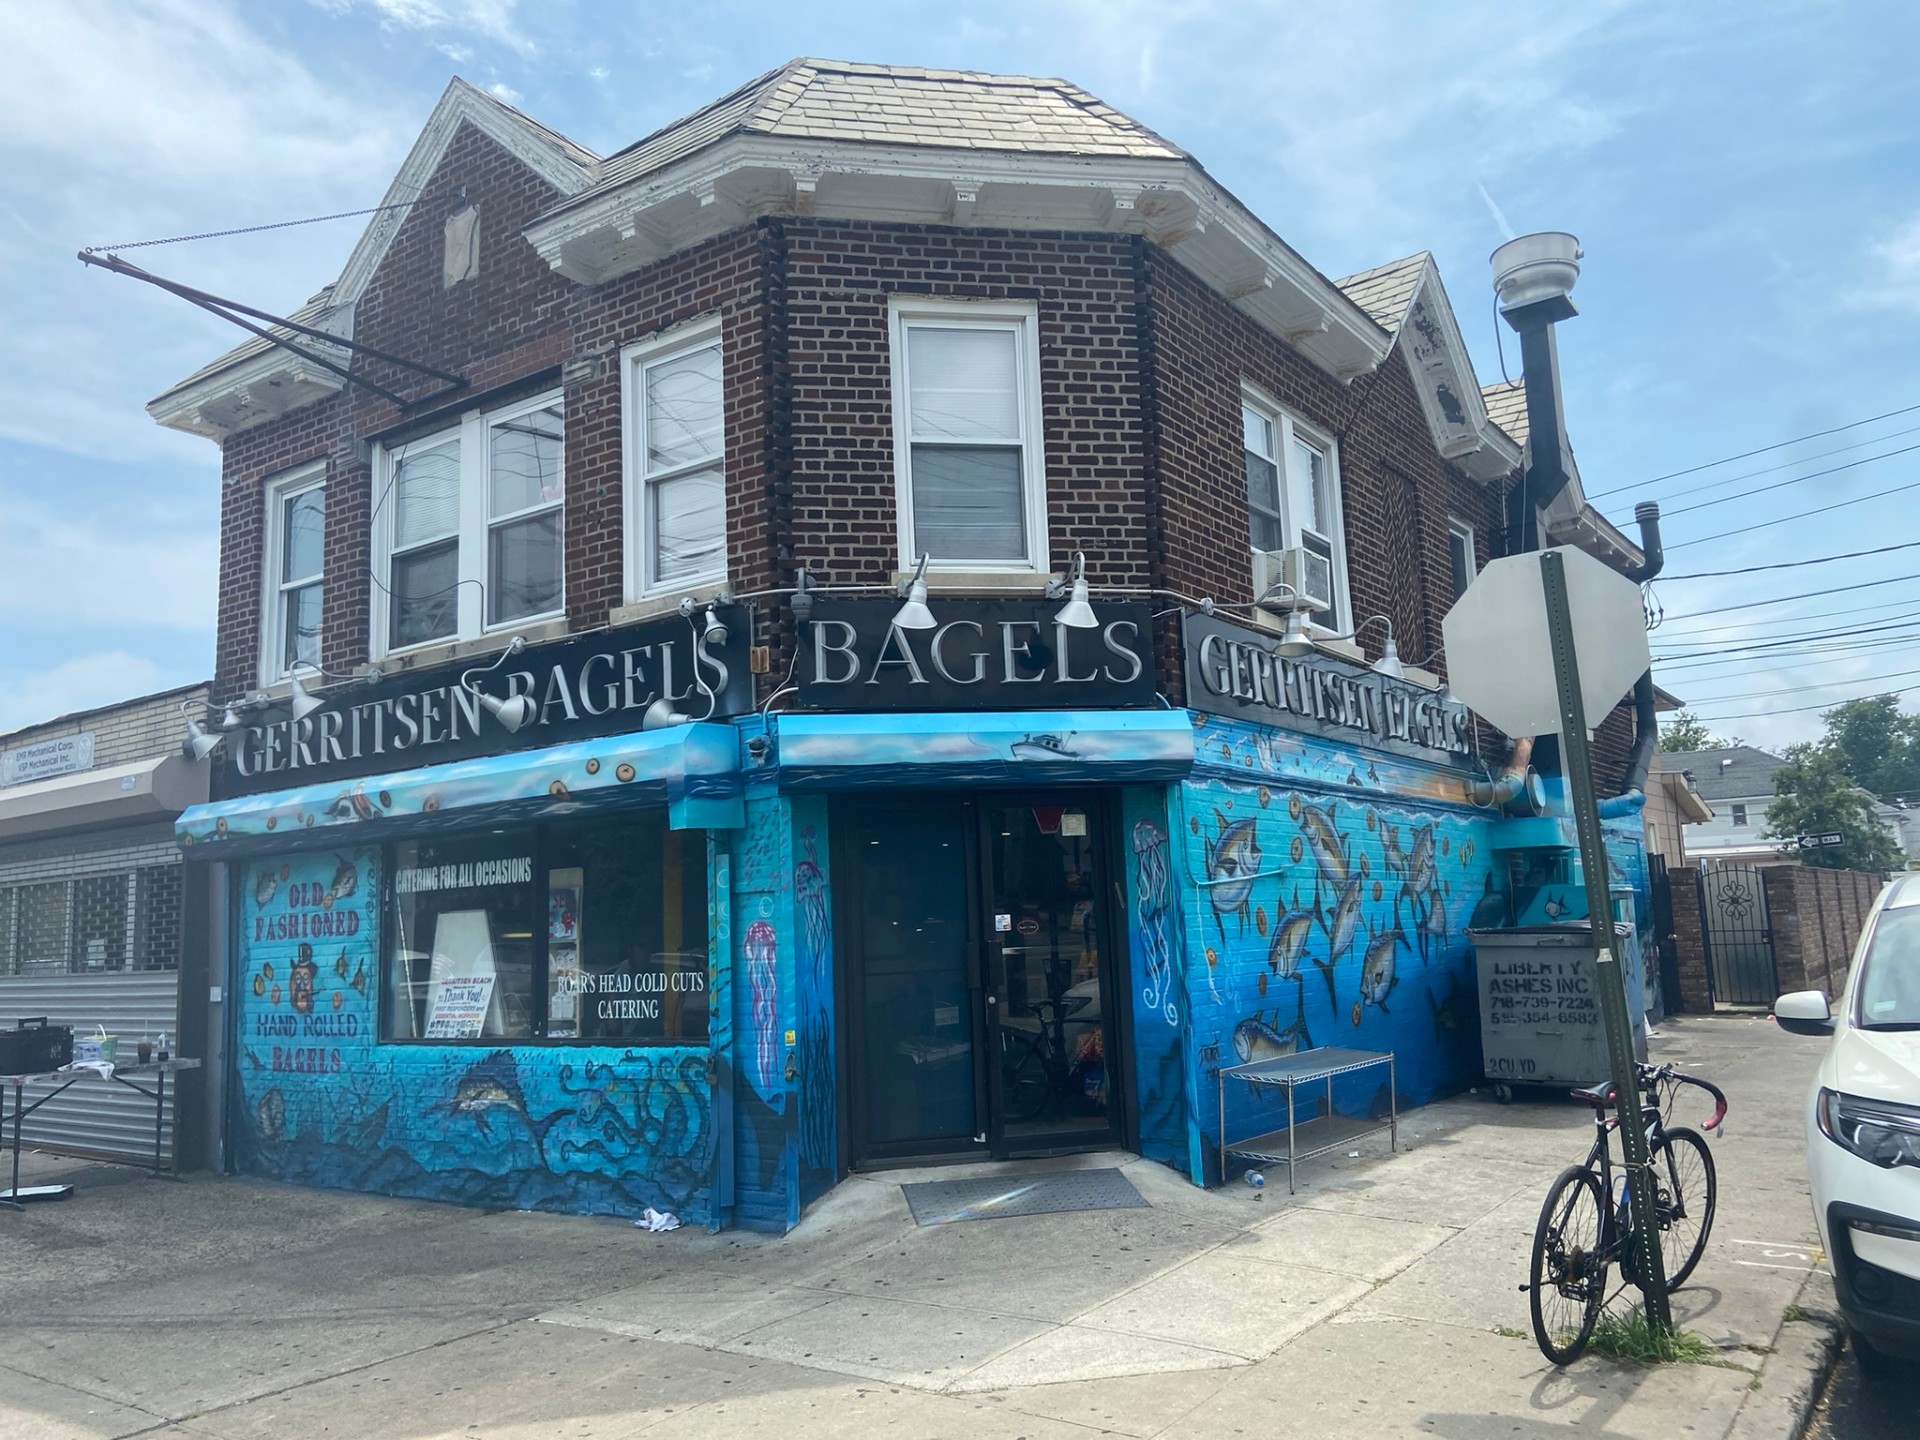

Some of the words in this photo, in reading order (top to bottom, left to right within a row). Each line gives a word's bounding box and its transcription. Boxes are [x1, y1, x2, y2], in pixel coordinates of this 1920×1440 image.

[809, 620, 1143, 684] BAGELS
[236, 680, 483, 777] GERRITSEN
[505, 635, 729, 728] BAGELS
[28, 743, 57, 758] Mechanical
[57, 742, 74, 751] Corp.
[29, 755, 58, 770] Mechanical
[396, 865, 438, 894] CATERING
[439, 864, 457, 889] FOR
[458, 862, 474, 888] ALL
[475, 856, 532, 887] OCCASIONS
[289, 882, 324, 908] OLD
[254, 910, 360, 942] FASHIONED
[444, 987, 465, 1003] Thank
[467, 986, 483, 1003] You!
[557, 973, 596, 994] BOAR'S
[598, 973, 631, 993] HEAD
[634, 972, 668, 992] COLD
[671, 971, 704, 992] CUTS
[1489, 978, 1553, 994] ASHES
[1557, 978, 1588, 994] INC
[597, 999, 659, 1019] CATERING
[256, 1014, 298, 1038] HAND
[303, 1014, 358, 1038] ROLLED
[272, 1046, 341, 1074] BAGELS
